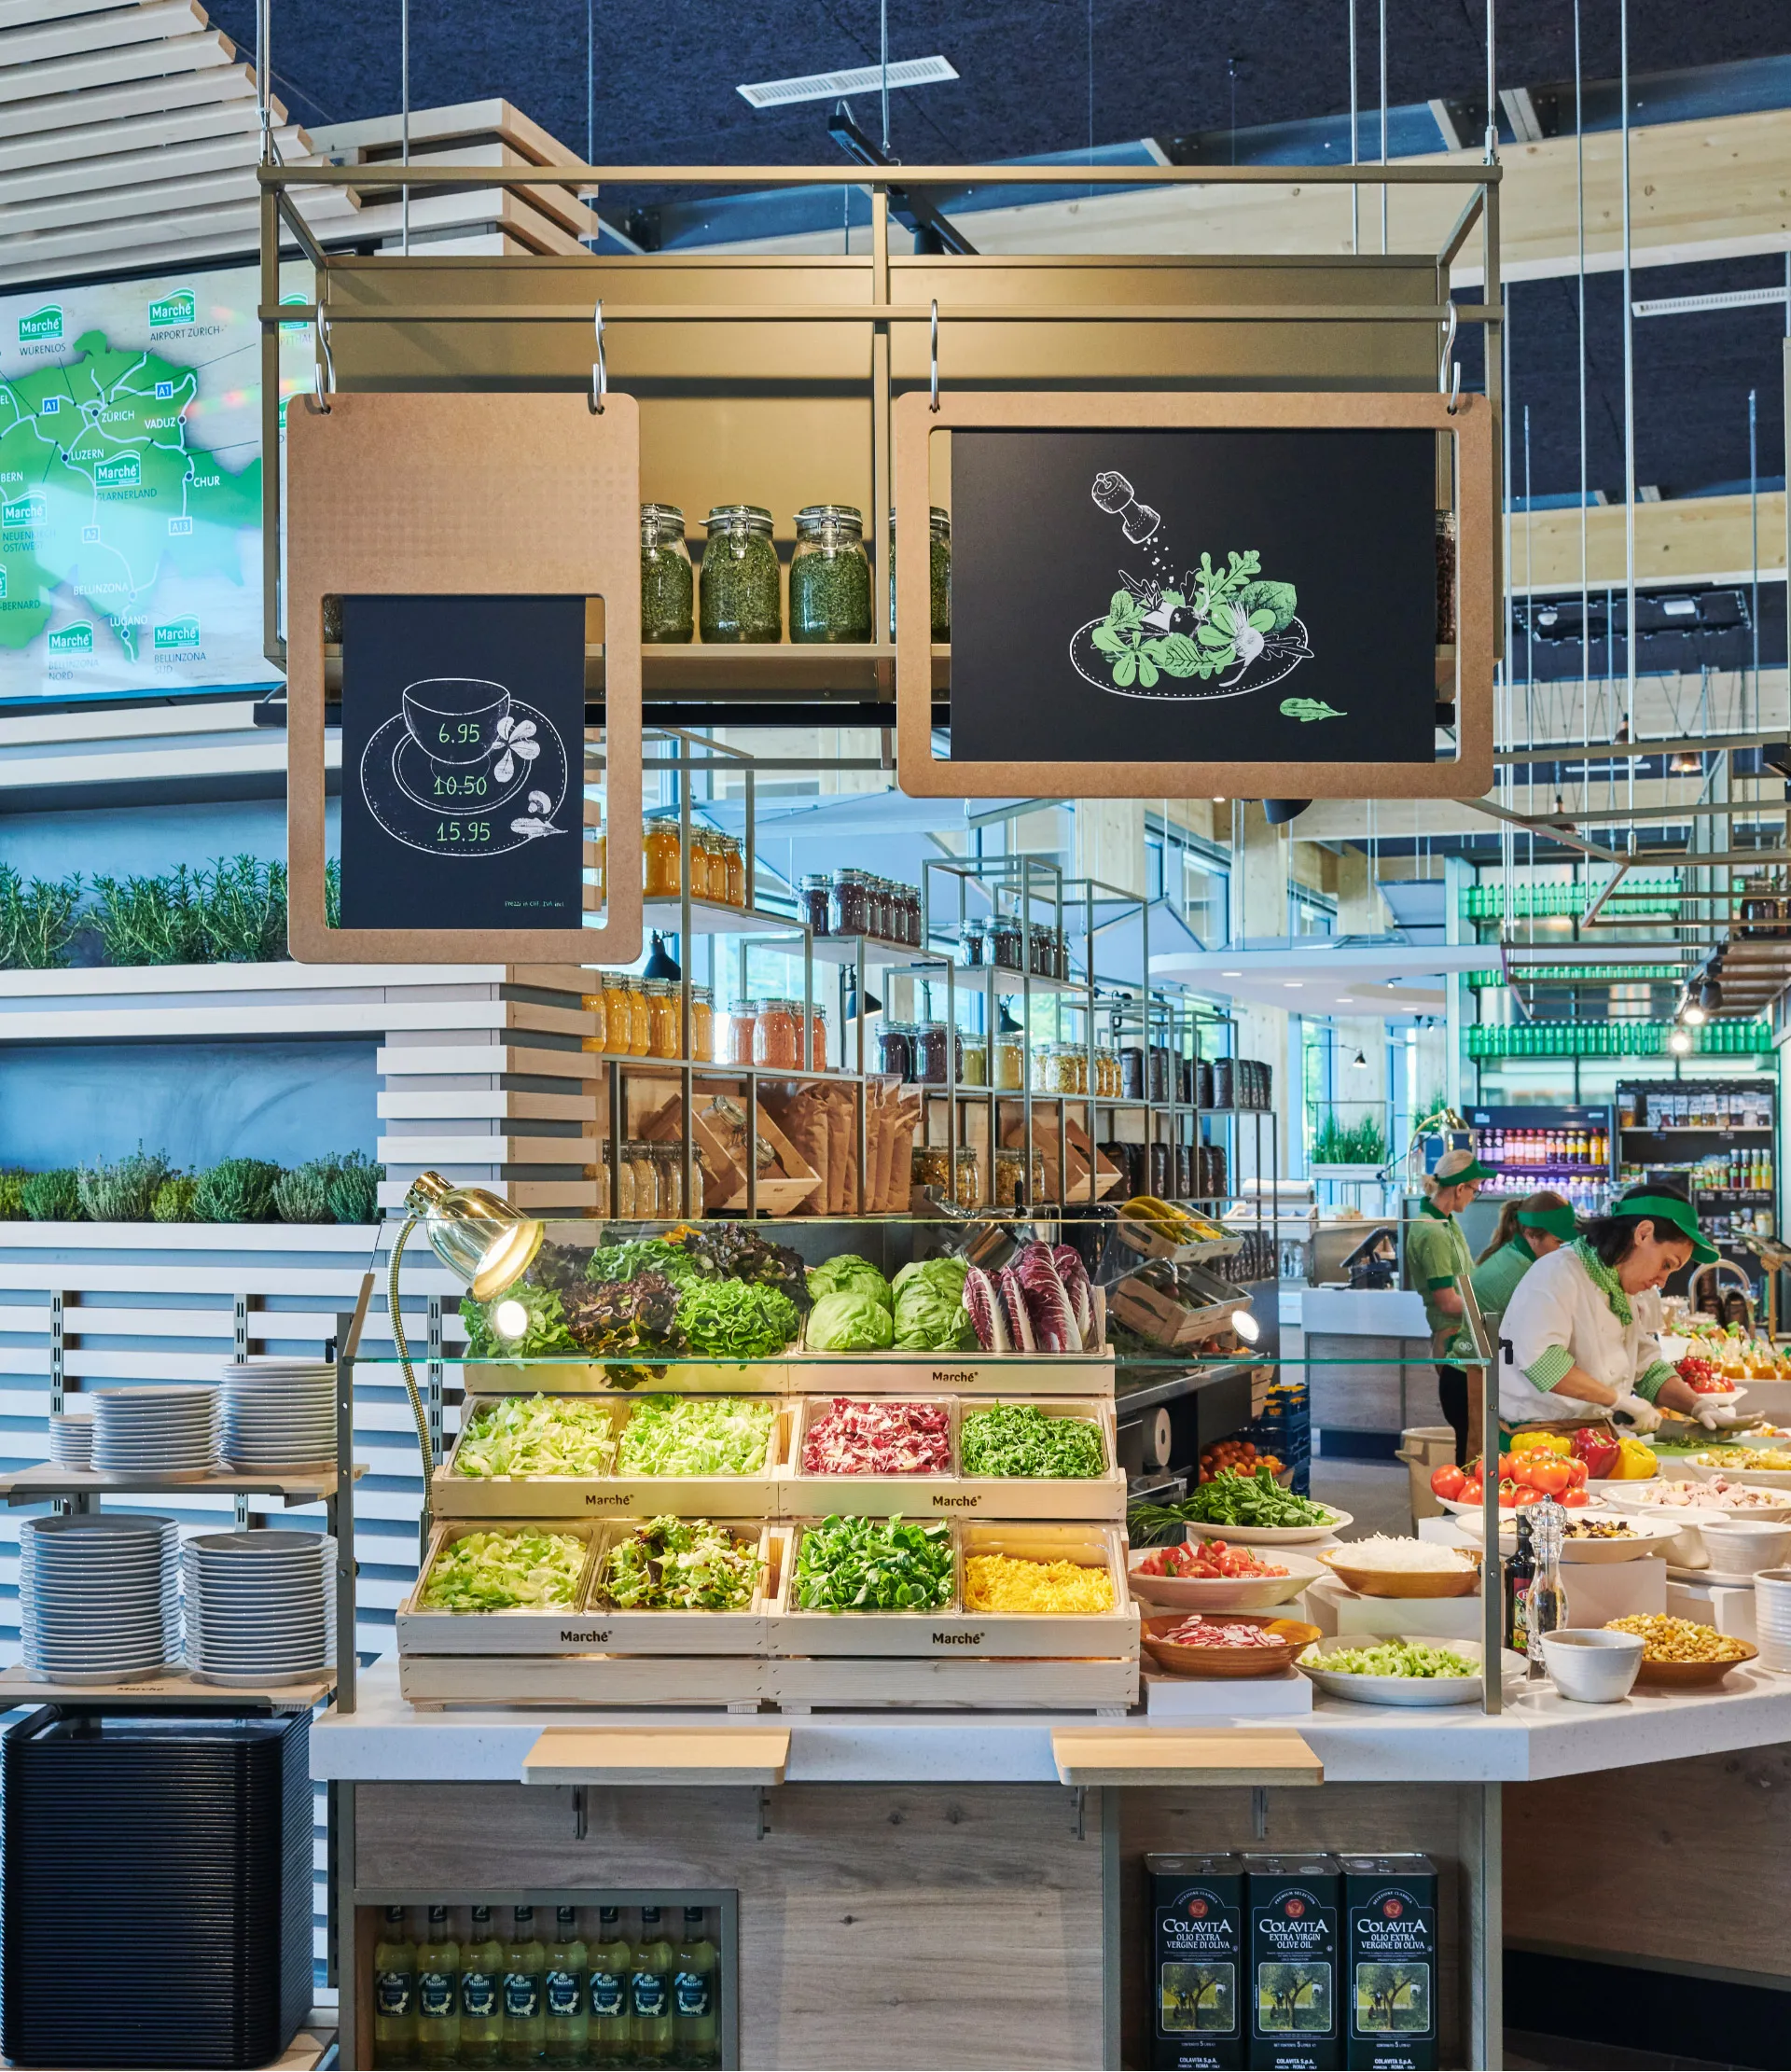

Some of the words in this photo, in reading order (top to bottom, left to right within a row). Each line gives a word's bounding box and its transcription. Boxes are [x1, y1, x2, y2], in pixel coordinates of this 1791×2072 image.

[152, 302, 190, 318] Marché
[21, 318, 59, 333] Marché
[150, 328, 185, 341] AIRPORT
[20, 343, 66, 355] WÜRENLOS
[159, 386, 169, 396] A1
[46, 402, 56, 410] A1
[102, 410, 134, 423] ZÜRICH
[145, 417, 175, 429] VADUZ
[71, 449, 104, 461] LUZERN
[1, 472, 23, 482] BERN
[99, 465, 136, 479] Marché
[193, 476, 220, 487] CHUR
[96, 488, 157, 501] GLARNERLAND
[173, 521, 187, 532] A13
[74, 582, 128, 595] BELLINZONA
[110, 615, 147, 627] LUGANO
[52, 633, 89, 647] Marché
[158, 627, 196, 640] Marché
[155, 652, 206, 663] BELLINZONA
[49, 671, 74, 680] NORD
[438, 723, 480, 744] 6.95
[434, 775, 487, 796] 10.50
[437, 822, 491, 841] 15.95
[1162, 1918, 1233, 1933] COLAVITA
[1259, 1918, 1330, 1933] COLAVITA
[1357, 1918, 1428, 1933] COLAVITA
